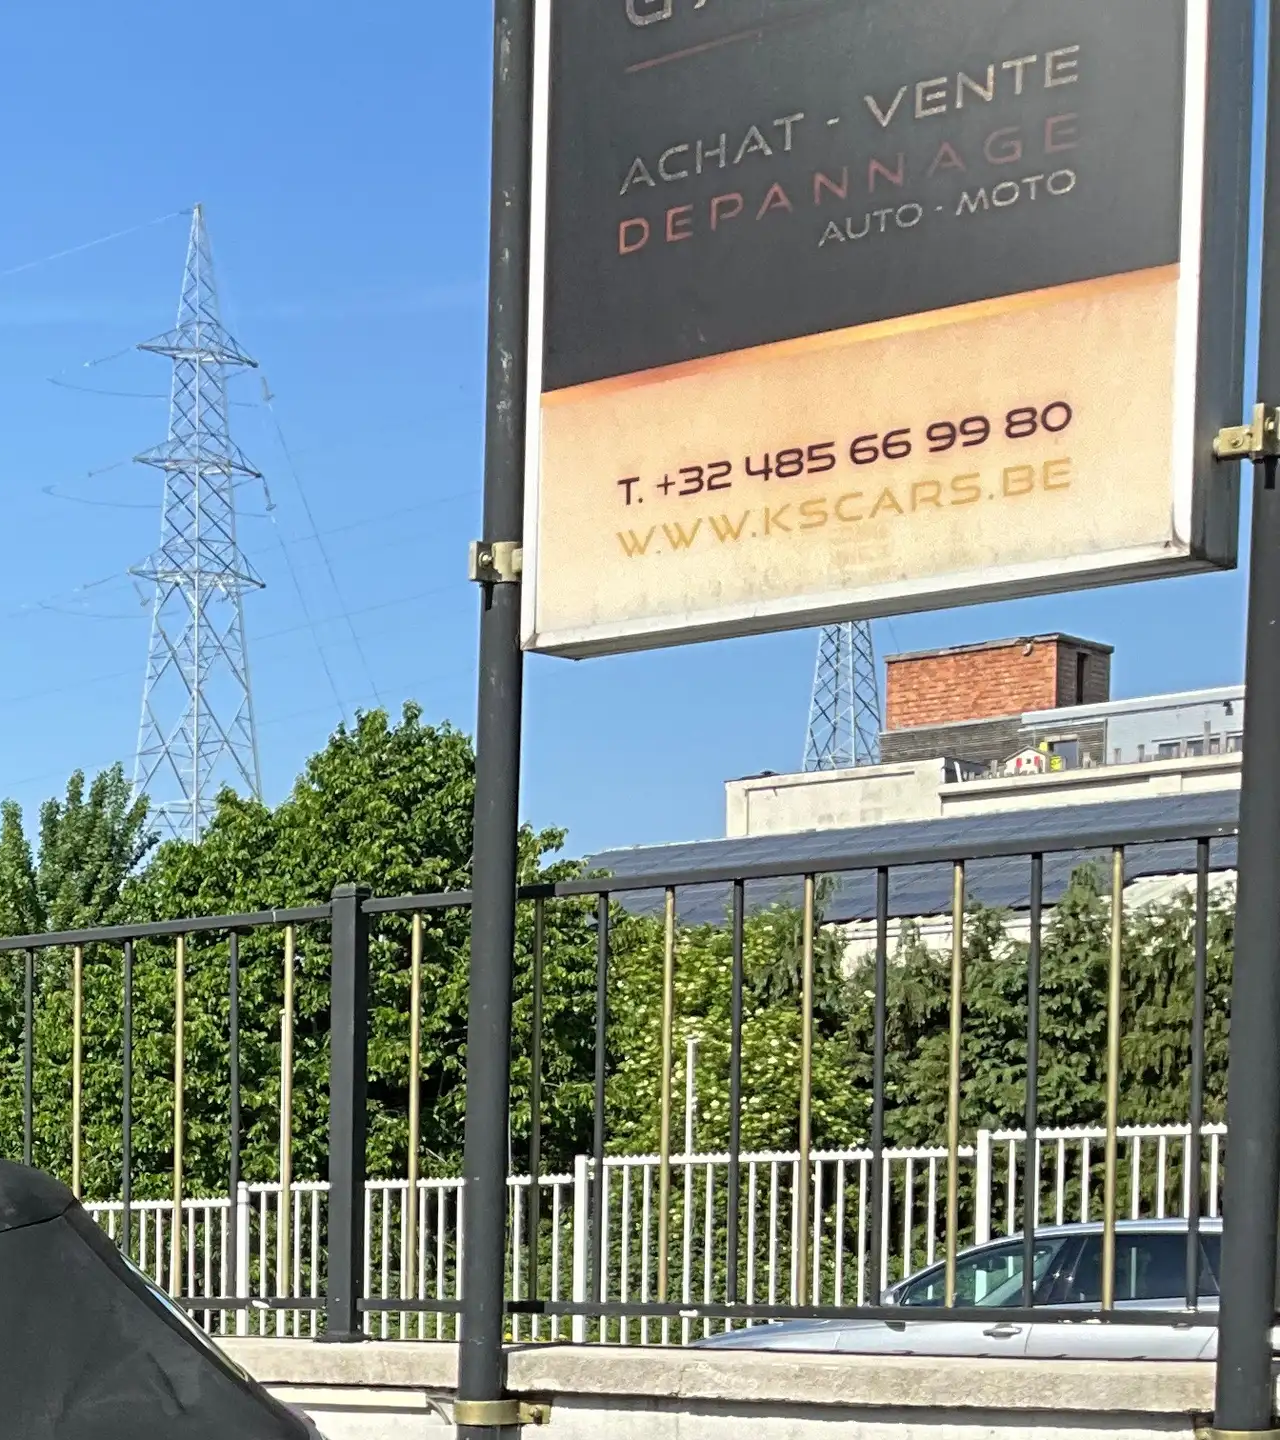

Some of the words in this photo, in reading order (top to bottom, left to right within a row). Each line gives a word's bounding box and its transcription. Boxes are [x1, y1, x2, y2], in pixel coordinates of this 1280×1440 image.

[619, 112, 805, 196] ACHAT
[863, 44, 1081, 128] VENTE
[618, 112, 1079, 256] DEPANNAGE
[818, 202, 924, 247] AUTO
[955, 168, 1077, 216] MOTO
[617, 476, 644, 506] T.
[656, 459, 733, 497] +32
[744, 440, 837, 482] 485
[848, 427, 913, 466] 66
[925, 414, 992, 454] 99
[1004, 400, 1074, 440] 80
[616, 456, 1075, 559] WWW.KSCARS.BE
